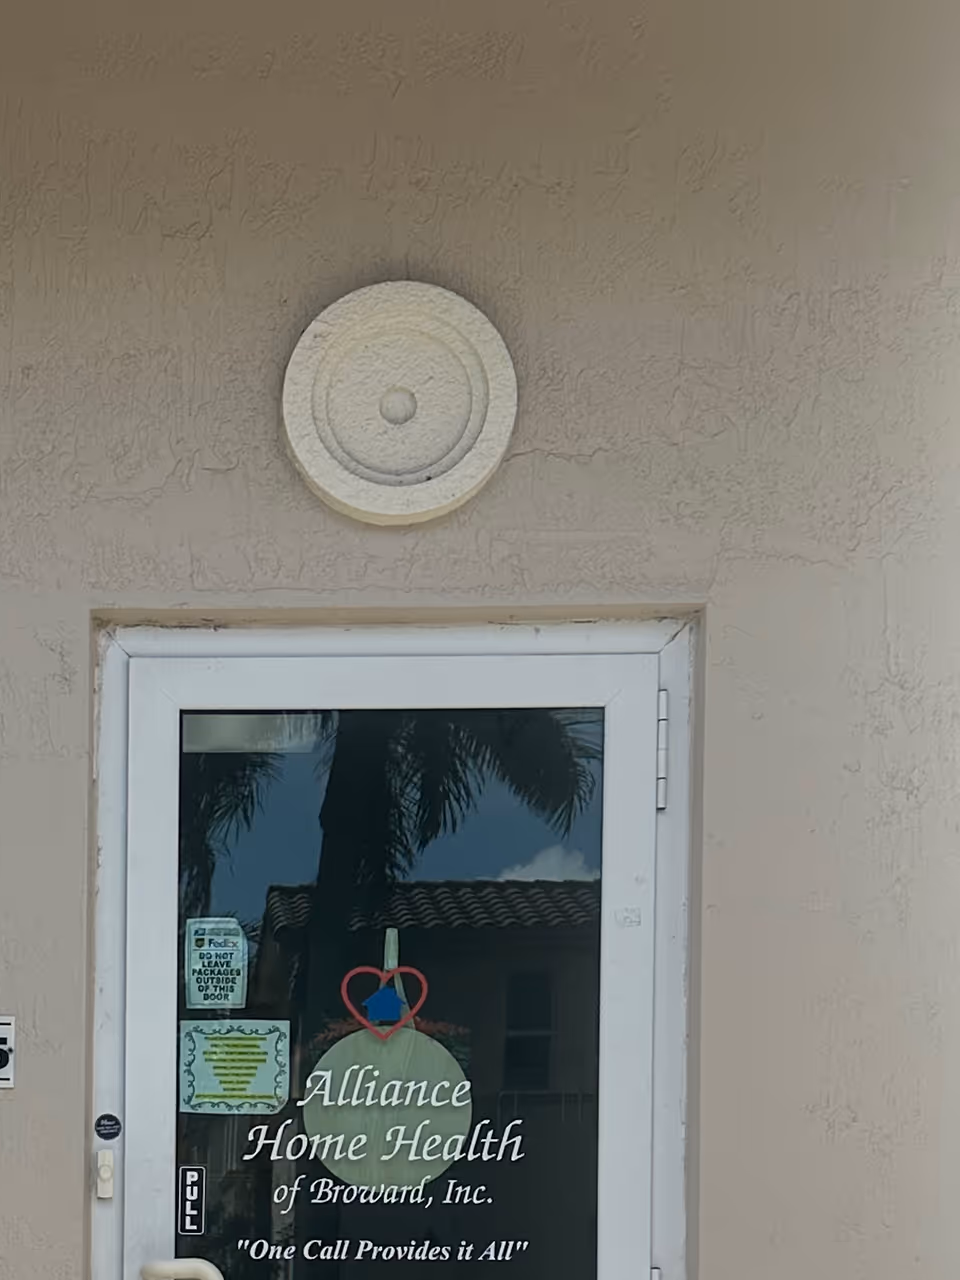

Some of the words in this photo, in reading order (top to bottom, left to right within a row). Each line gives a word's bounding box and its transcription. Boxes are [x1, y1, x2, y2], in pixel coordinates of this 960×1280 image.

[208, 938, 239, 949] FedEx
[199, 952, 213, 960] DO
[215, 952, 234, 960] NOT
[202, 960, 232, 968] LEAVE
[192, 968, 241, 977] PACKAGES
[196, 976, 237, 985] OUTSIDE
[198, 984, 210, 992] OF
[212, 985, 235, 993] THIS
[203, 993, 230, 1001] DOOR
[296, 1064, 472, 1107] Alliance
[242, 1118, 368, 1161] Home
[380, 1119, 525, 1161] Health
[273, 1174, 307, 1214] of
[310, 1175, 434, 1208] Broward,
[442, 1178, 493, 1204] Inc.
[185, 1170, 199, 1230] PULL
[237, 1239, 296, 1261] "One
[302, 1239, 348, 1261] Call
[354, 1240, 451, 1261] Provides
[456, 1241, 474, 1261] it
[477, 1241, 529, 1261] All"
